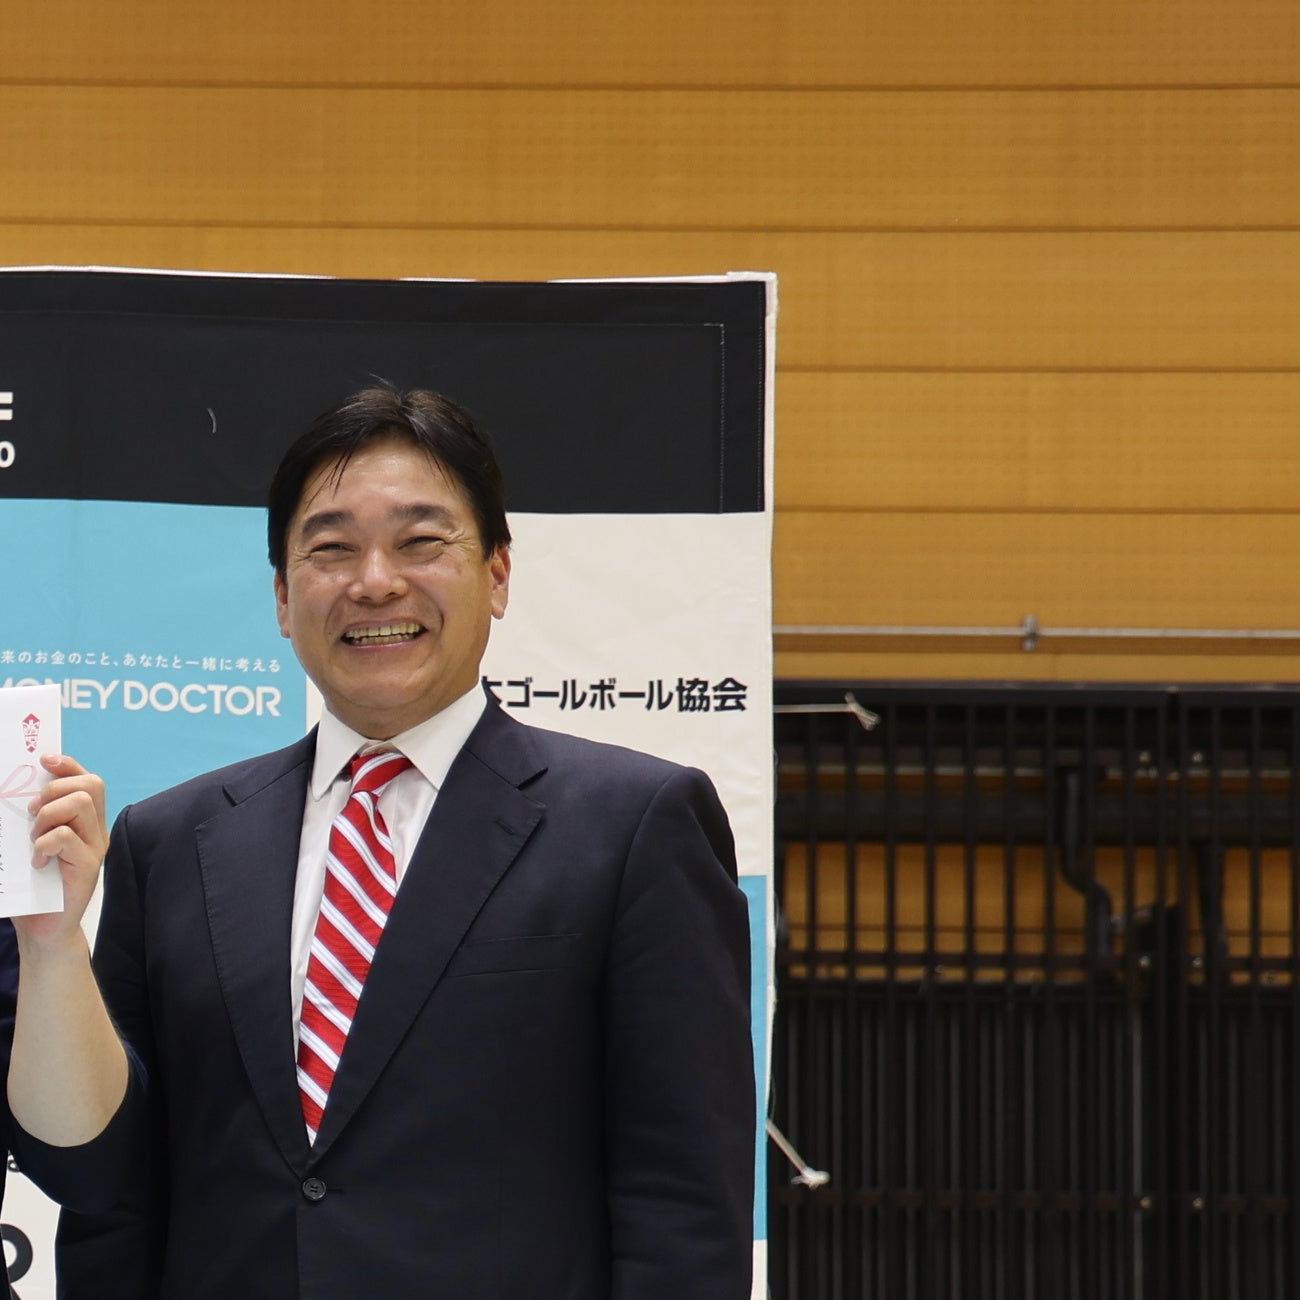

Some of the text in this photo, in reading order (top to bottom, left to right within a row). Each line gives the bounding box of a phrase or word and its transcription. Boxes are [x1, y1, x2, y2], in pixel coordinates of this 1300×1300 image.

[122, 679, 282, 717] DOCTOR
[482, 675, 748, 713] ゴールボール協会
